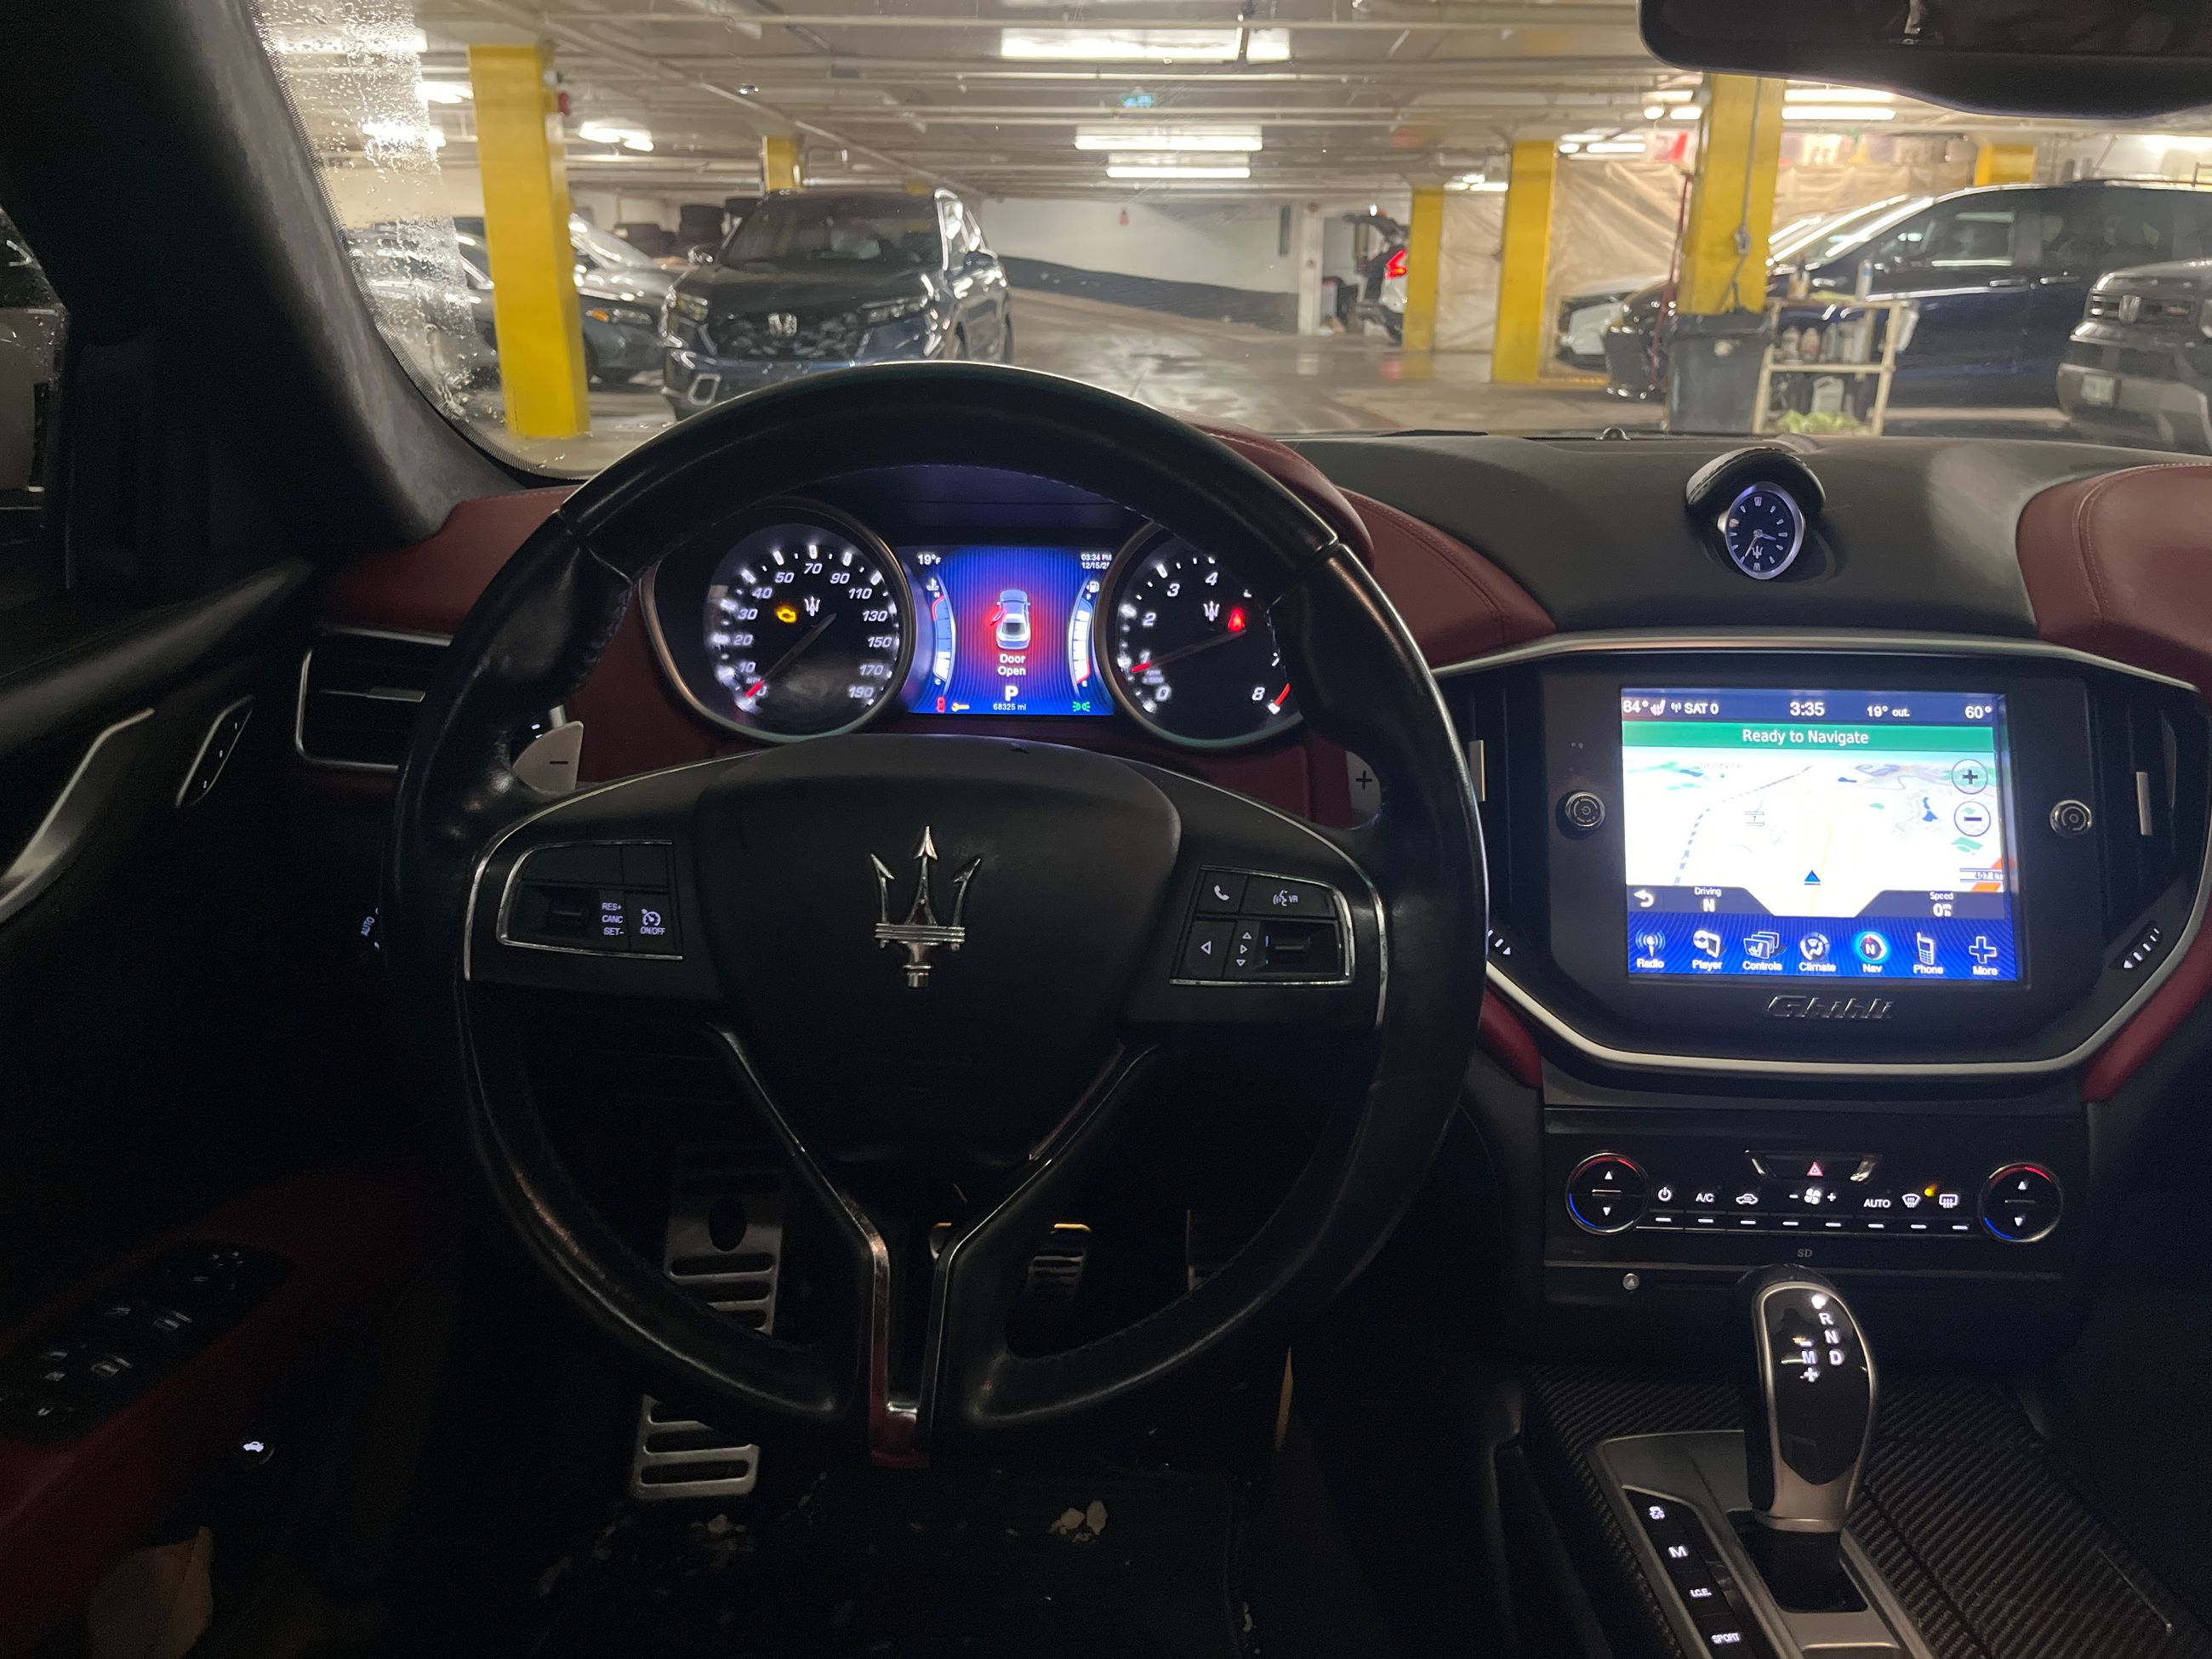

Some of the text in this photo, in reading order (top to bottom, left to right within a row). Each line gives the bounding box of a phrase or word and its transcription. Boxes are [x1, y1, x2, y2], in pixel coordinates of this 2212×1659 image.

[803, 562, 823, 574] 70
[775, 572, 795, 584] 50
[830, 573, 850, 584] 90
[1205, 571, 1218, 586] 4
[752, 587, 773, 600] 40
[848, 588, 873, 600] 110
[1166, 583, 1181, 597] 3
[738, 608, 758, 621] 30
[862, 610, 888, 622] 130
[1142, 612, 1157, 627] 2
[733, 634, 754, 647] 20
[867, 636, 892, 648] 150
[999, 653, 1026, 664] Door
[738, 661, 756, 673] 10
[858, 664, 884, 676] 170
[997, 666, 1027, 677] Open
[847, 686, 875, 698] 190
[1004, 685, 1018, 702] P
[1155, 685, 1172, 702] 0
[1251, 687, 1265, 701] 8
[993, 703, 1016, 711] 68325
[1684, 703, 1719, 715] SAT 0
[1789, 701, 1826, 716] 3:35
[1891, 707, 1911, 718] out.
[1964, 705, 1993, 720] 60°
[1742, 728, 1869, 747] Ready to Navigate
[1694, 887, 1722, 898] Driving
[1930, 892, 1954, 901] Speed
[1288, 895, 1298, 904] VR
[1702, 898, 1716, 913] N
[601, 902, 622, 911] RES+
[601, 915, 624, 924] CANC
[360, 915, 375, 937] AUTO
[640, 926, 666, 936] ON/OFF
[1865, 944, 1875, 955] N
[1636, 958, 1665, 969] Radio
[1691, 959, 1723, 971] Player
[1742, 961, 1783, 972] Controls
[1799, 962, 1836, 972] Climate
[1862, 963, 1883, 973] Nav
[1913, 964, 1944, 974] Phone
[1972, 966, 1998, 976] More
[1695, 1193, 1714, 1204] A/C
[1863, 1198, 1891, 1209] AUTO
[1797, 1248, 1813, 1258] SD
[1818, 1312, 1834, 1325] R
[1824, 1330, 1839, 1344] N
[1801, 1350, 1817, 1365] M
[1829, 1349, 1844, 1366] D
[1668, 1545, 1689, 1559] M
[1711, 1633, 1742, 1645] SPORT
